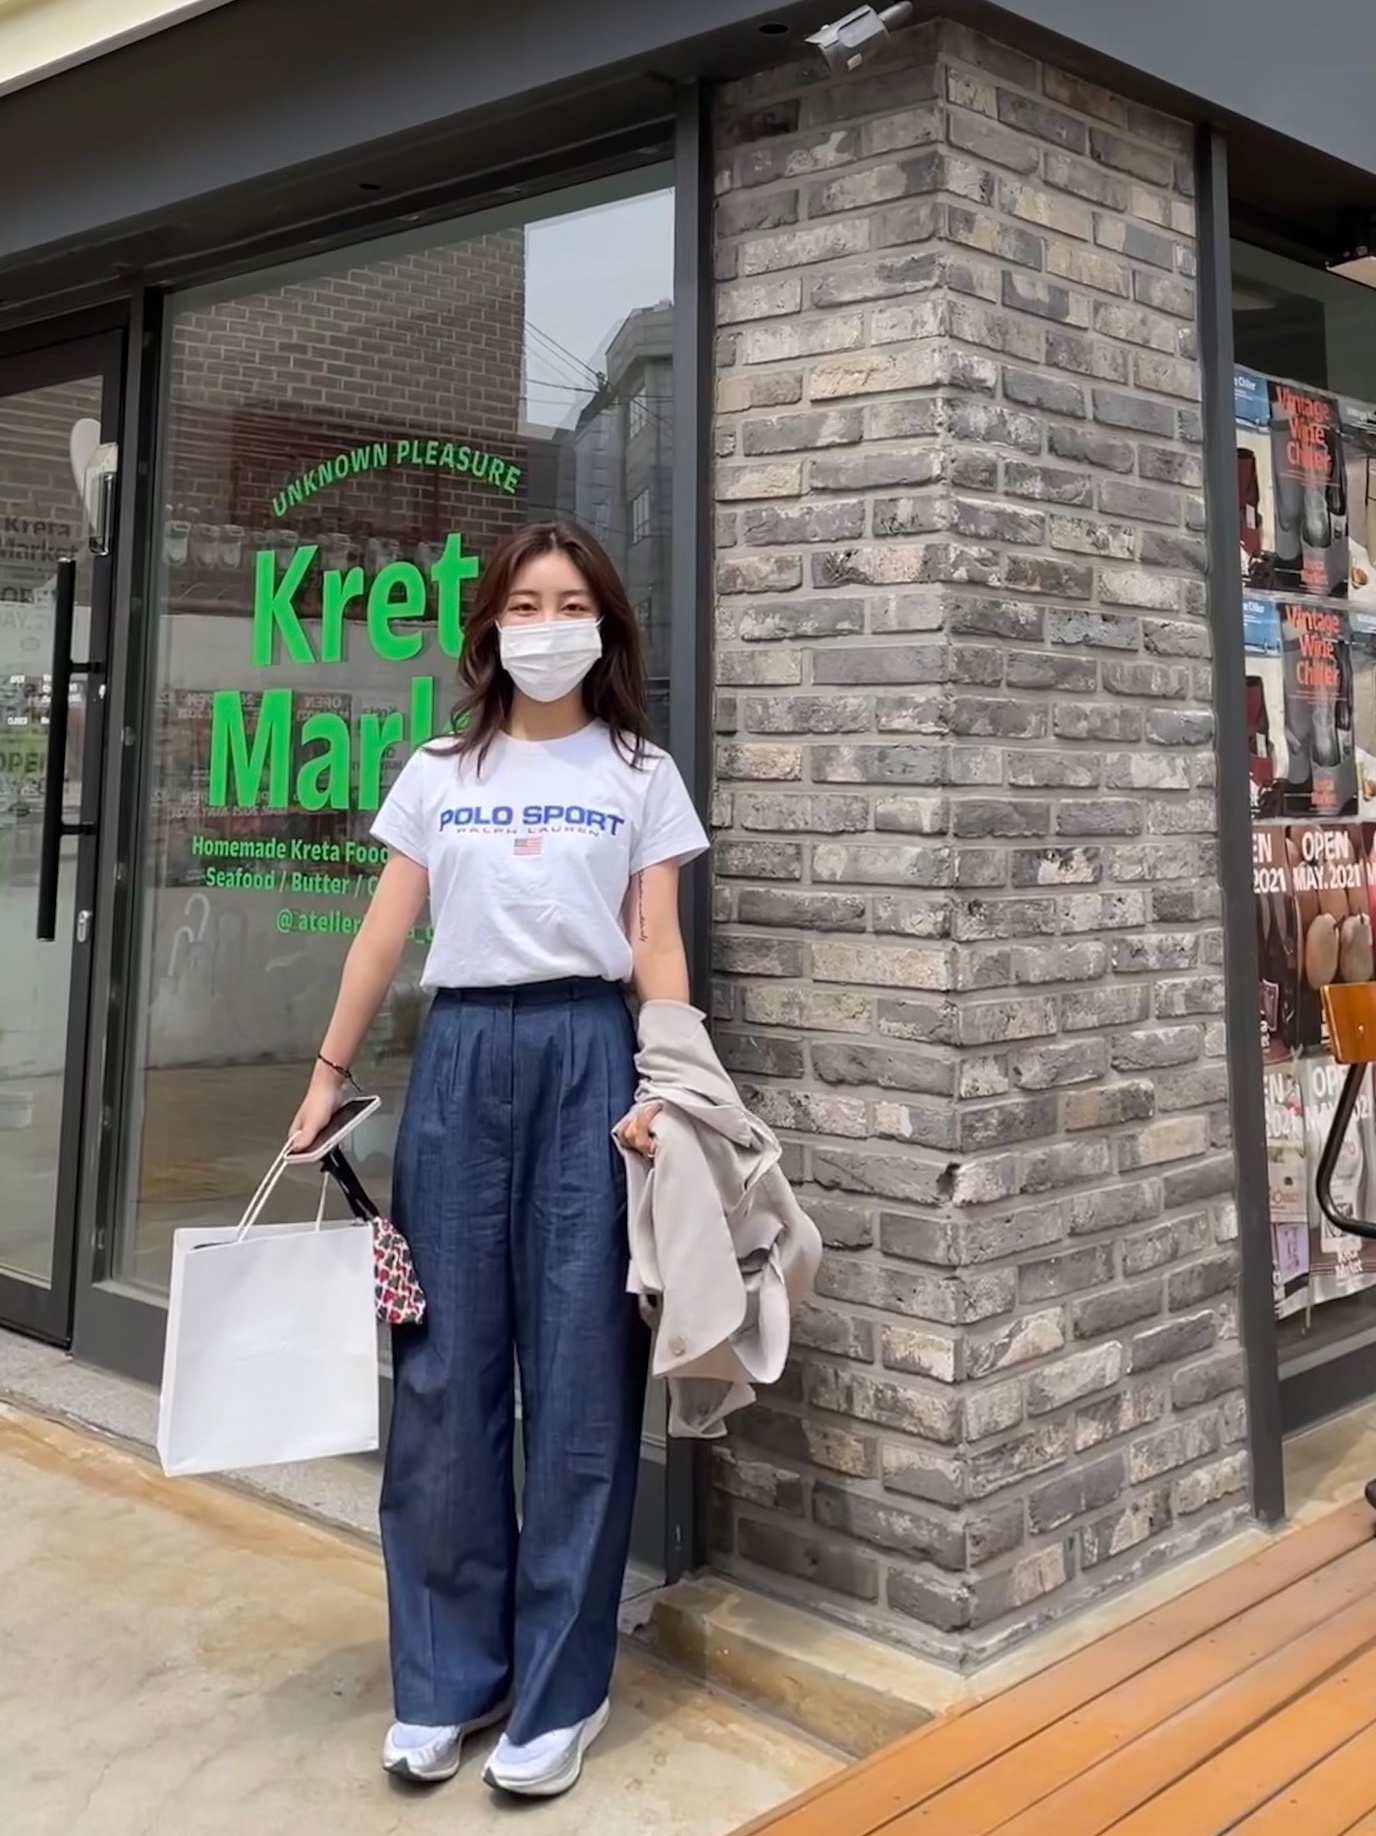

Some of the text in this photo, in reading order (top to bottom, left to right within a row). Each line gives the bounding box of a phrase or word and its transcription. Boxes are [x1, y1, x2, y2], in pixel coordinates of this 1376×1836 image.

[271, 440, 521, 517] UNKNOWN PLEASURE
[251, 532, 479, 667] Kret
[1299, 633, 1336, 661] Wine
[439, 805, 625, 836] POLO SPORT
[527, 826, 600, 837] LAUREN
[192, 835, 286, 859] Homemade
[291, 839, 340, 862] Kreta
[1302, 831, 1349, 861] OPEN
[206, 867, 275, 890] Seafood
[292, 872, 350, 894] Butter
